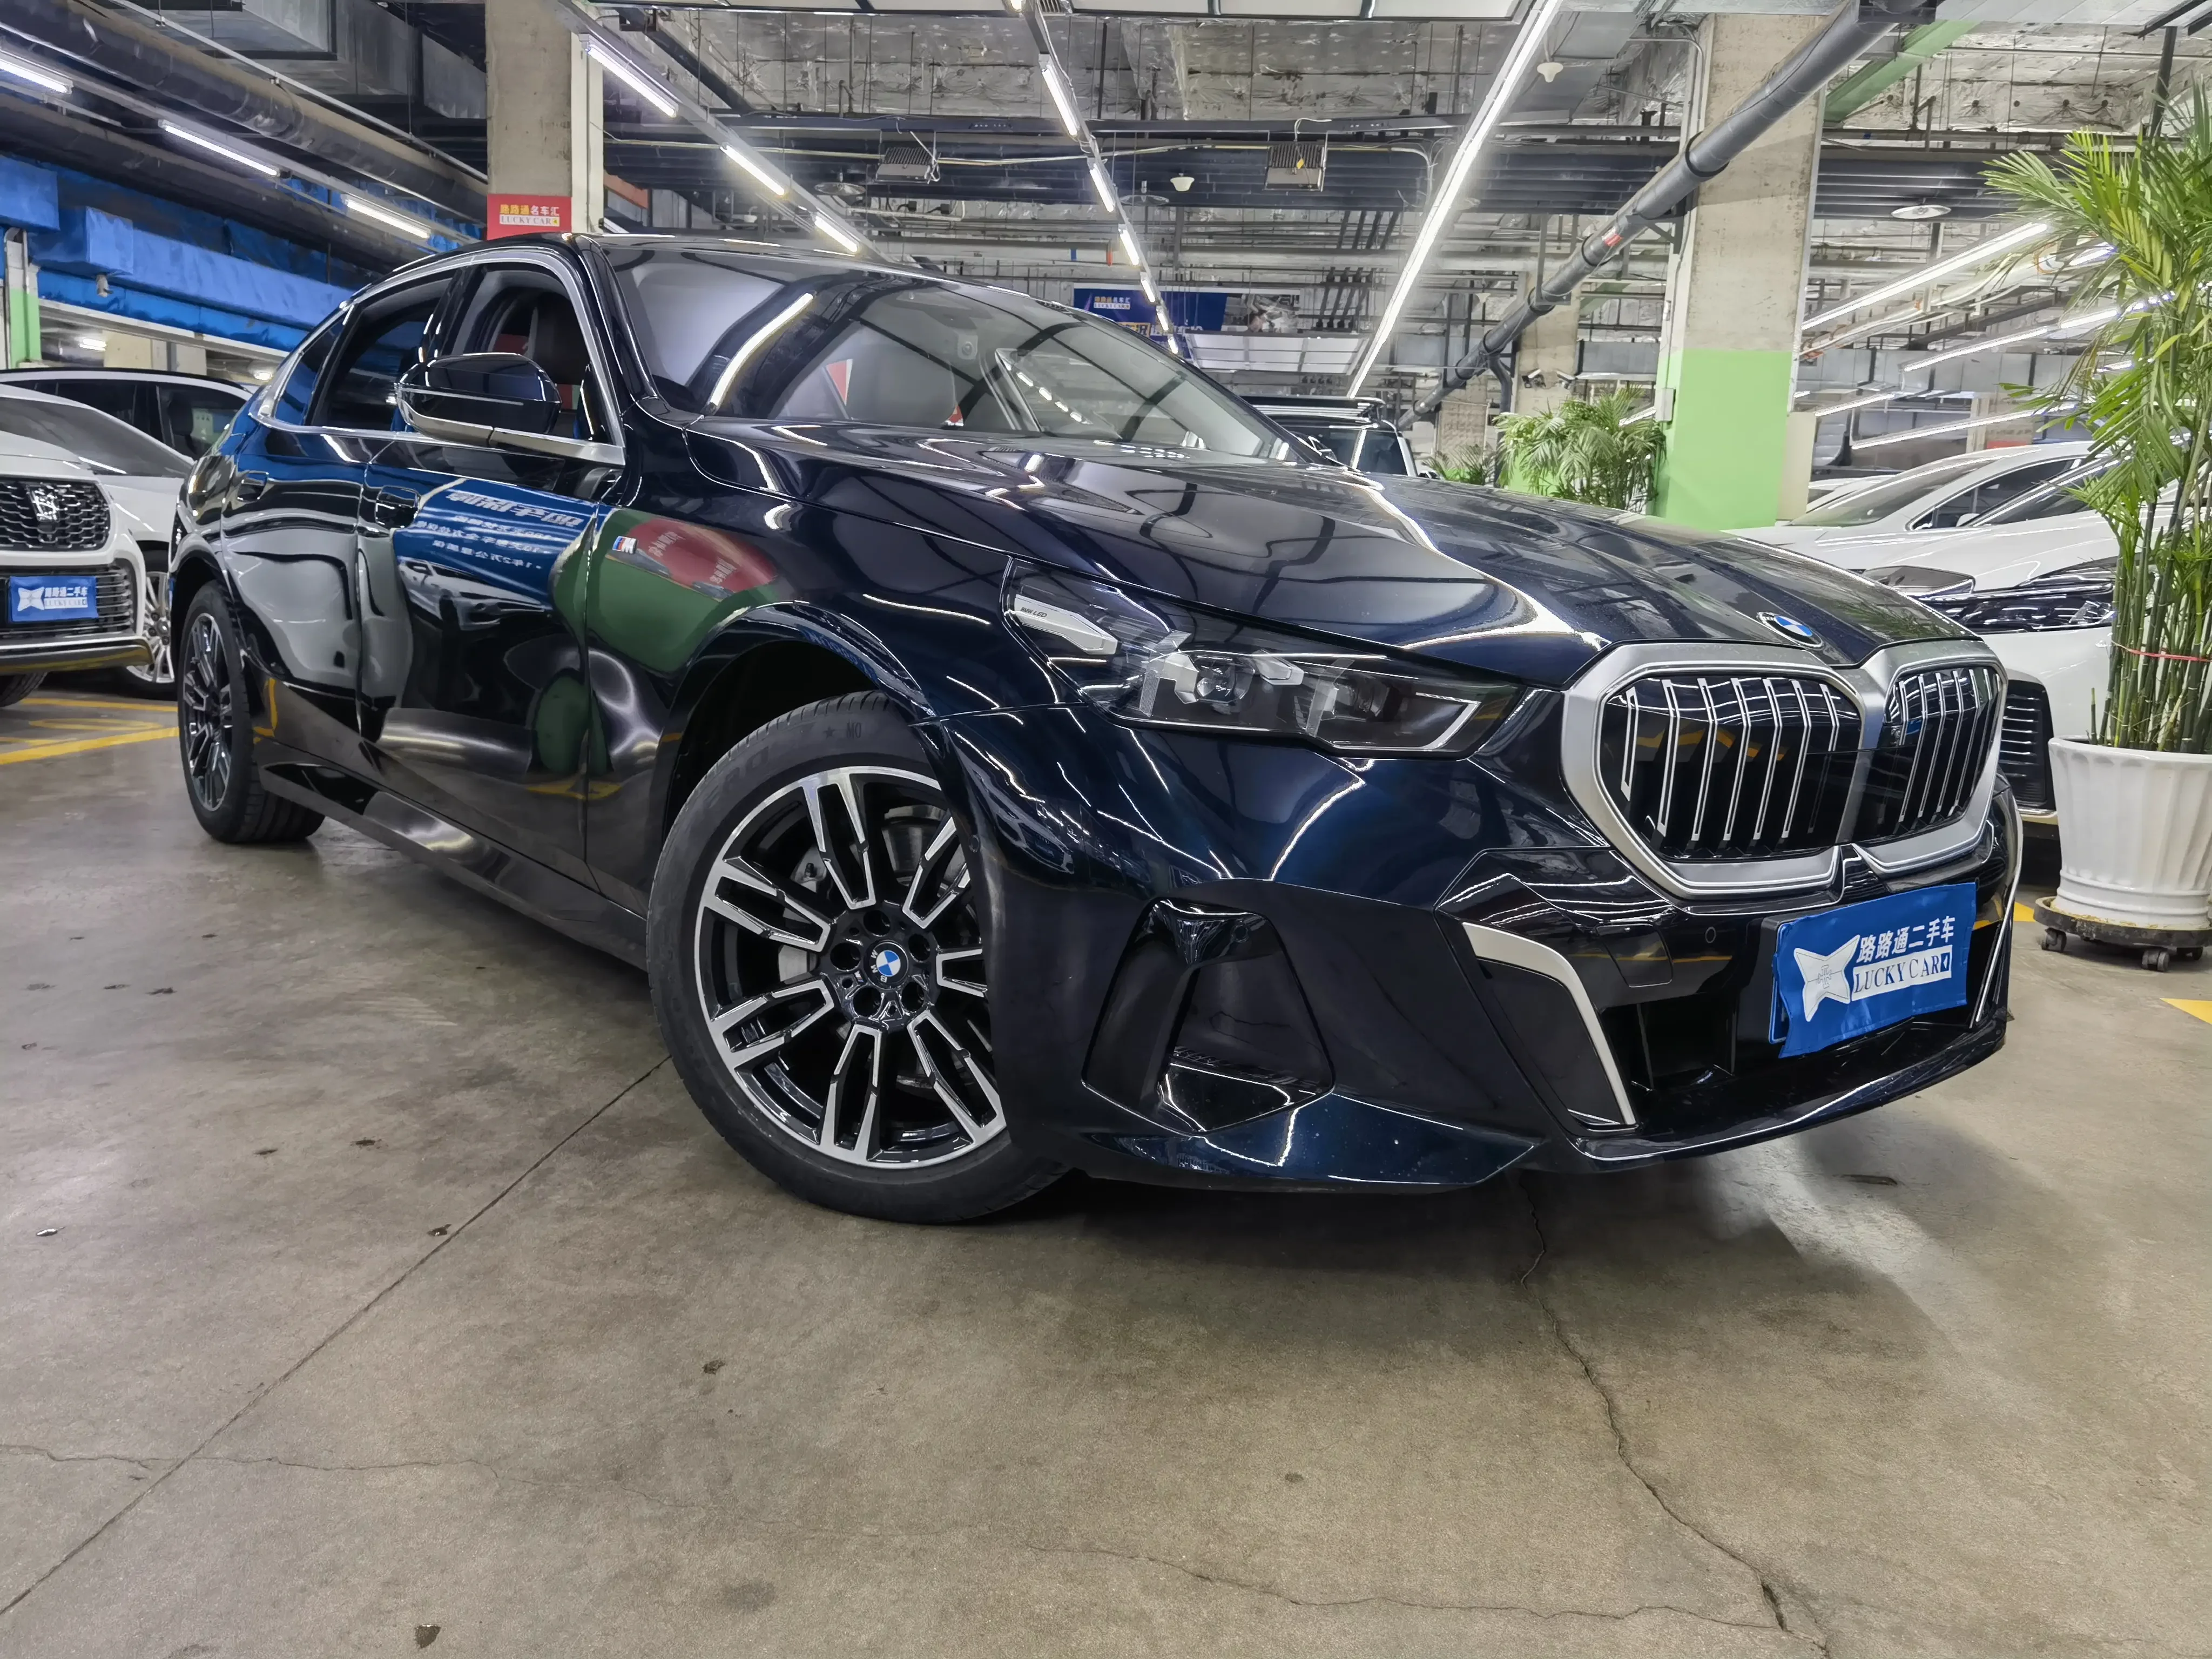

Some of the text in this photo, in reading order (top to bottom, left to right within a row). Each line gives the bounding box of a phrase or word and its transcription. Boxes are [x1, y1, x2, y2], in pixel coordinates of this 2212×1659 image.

[501, 215, 531, 224] LUCKY
[1856, 915, 1955, 963] 路路通二手车
[871, 949, 888, 983] BMW
[1854, 955, 1940, 994] LUCKY CAR
